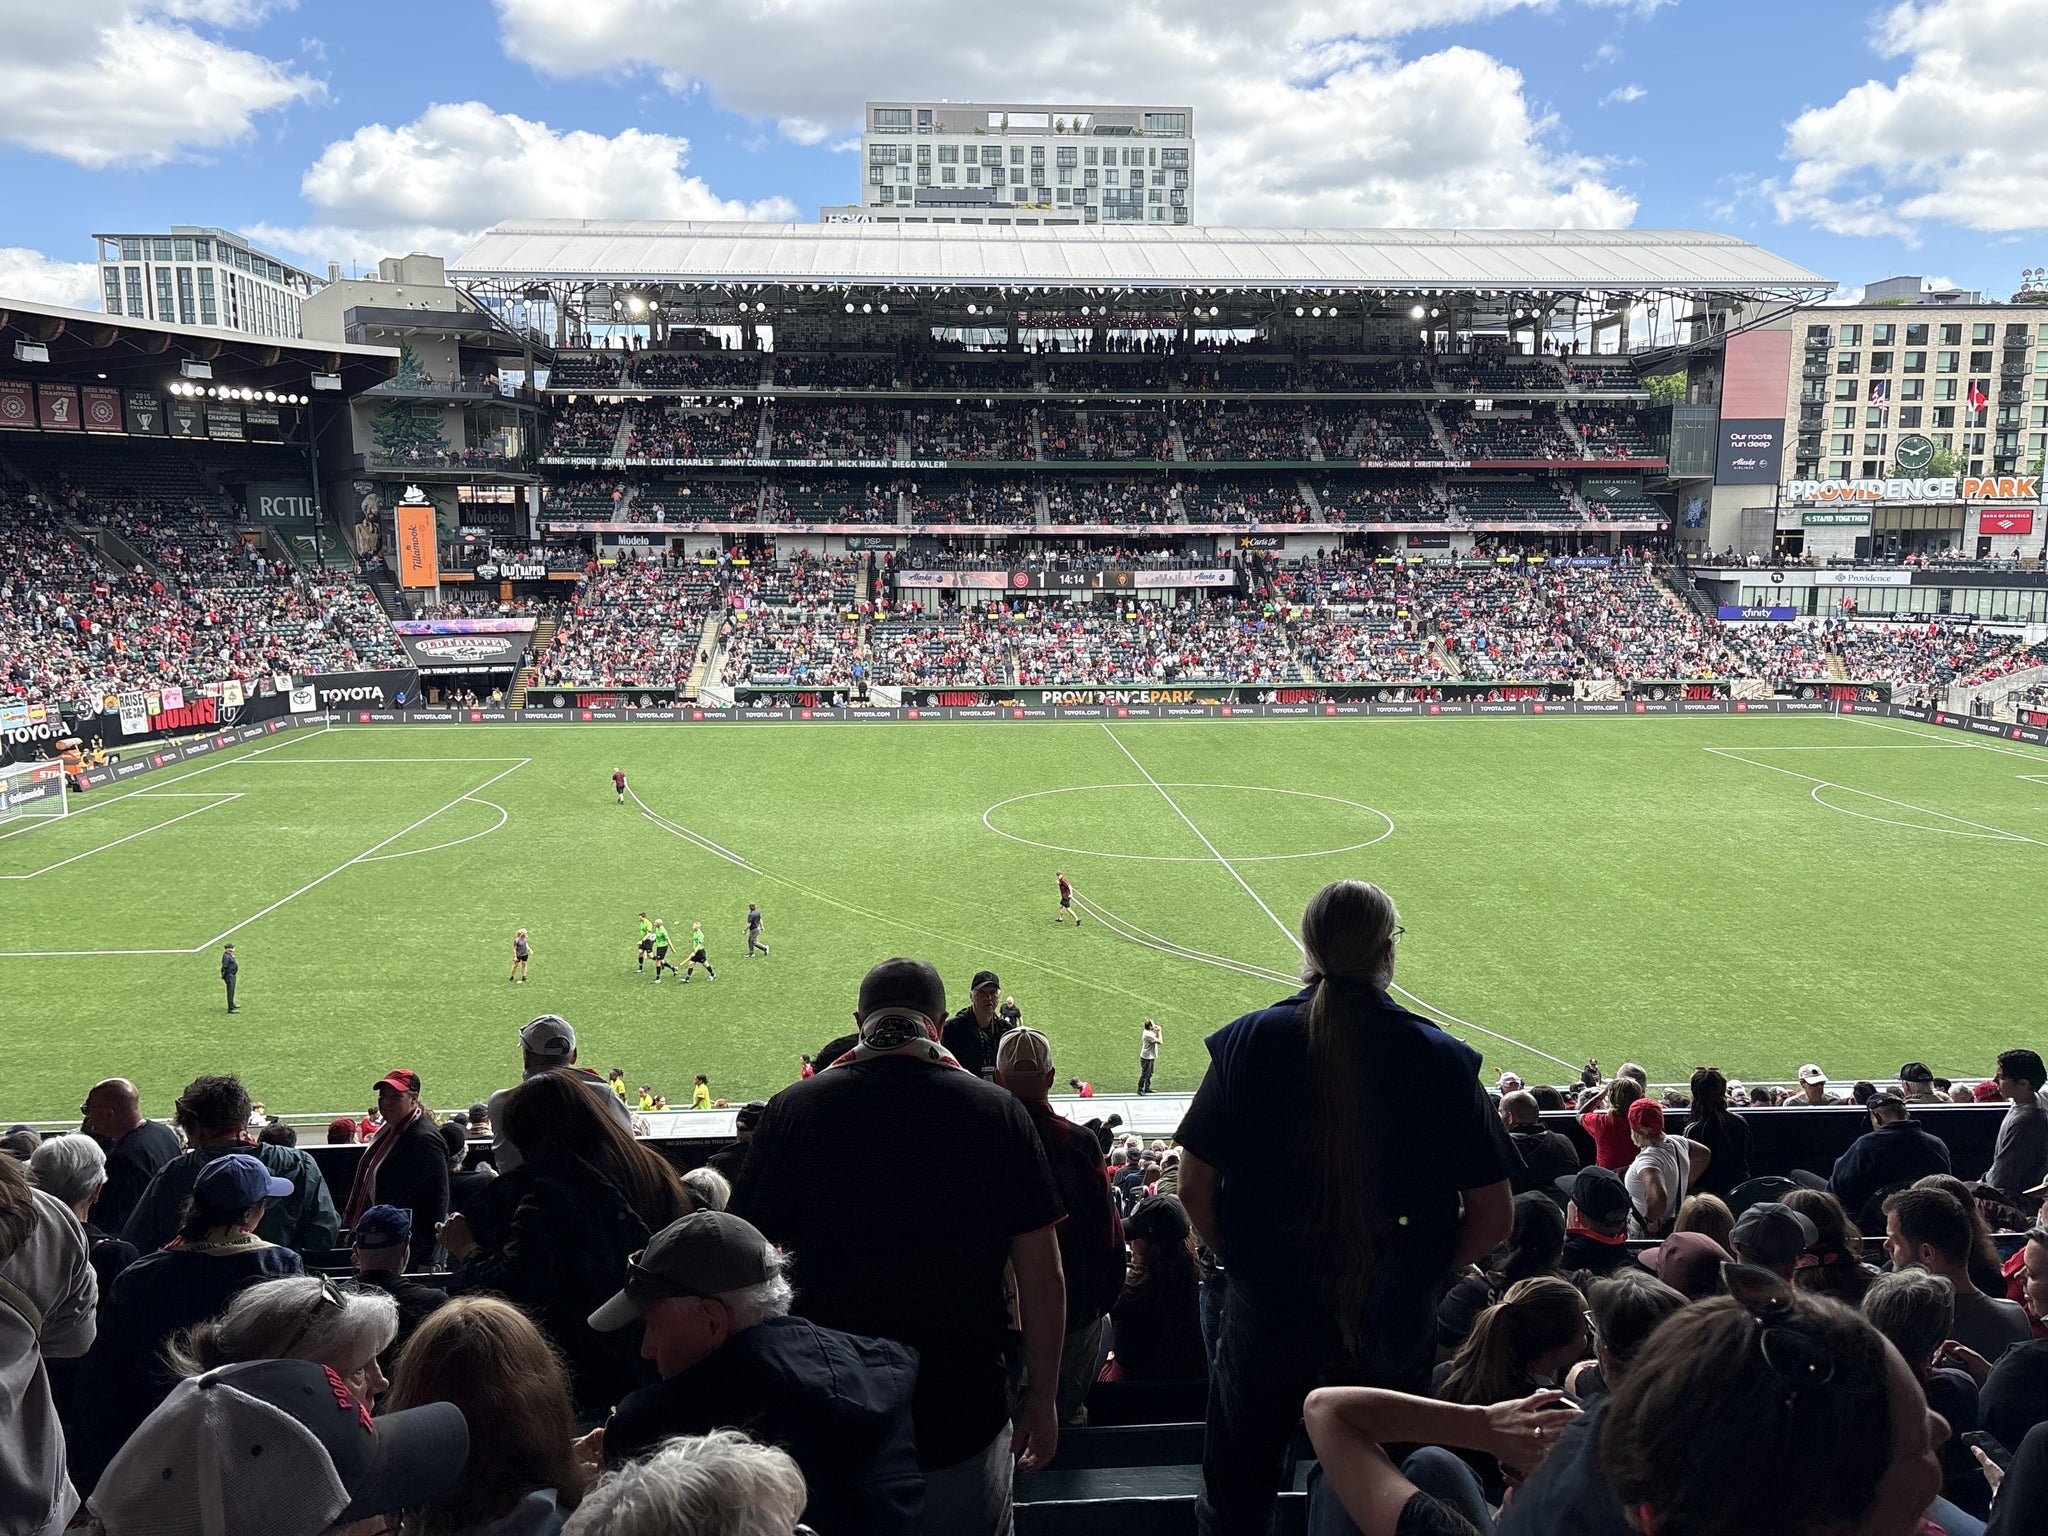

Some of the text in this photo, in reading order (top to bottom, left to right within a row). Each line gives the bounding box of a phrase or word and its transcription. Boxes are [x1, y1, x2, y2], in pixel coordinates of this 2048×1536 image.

[1732, 458, 1756, 466] Alaska
[1787, 476, 2041, 500] PROVIDENCE PARK
[466, 508, 509, 524] Modelo
[618, 534, 649, 545] Modelo
[408, 524, 422, 570] Tillamook
[514, 564, 545, 579] TRAPPER
[908, 573, 932, 581] Alaska
[1037, 571, 1045, 588] 1
[1060, 575, 1084, 584] 14:14
[1096, 572, 1103, 588] 1
[1848, 574, 1891, 582] Providence
[452, 588, 489, 602] TRAPPER
[1741, 607, 1772, 618] xfinity
[1892, 613, 1917, 621] Ford
[418, 638, 512, 650] OLD TRAPPER
[320, 686, 384, 702] TOYOTA
[938, 692, 977, 705] THORNS
[1042, 690, 1195, 704] PROVIDENCE PARK
[1276, 689, 1315, 703] THORNS
[1688, 686, 1711, 699] 2012
[1815, 686, 1857, 700] TRNS
[119, 694, 143, 708] RAISE
[121, 708, 133, 719] THE
[303, 714, 340, 723] TOYOTA.COM
[162, 753, 176, 762] TOYOTA
[39, 770, 61, 779] STI
[118, 763, 144, 775] TOYOTA.COM
[89, 774, 107, 783] TOYOTA
